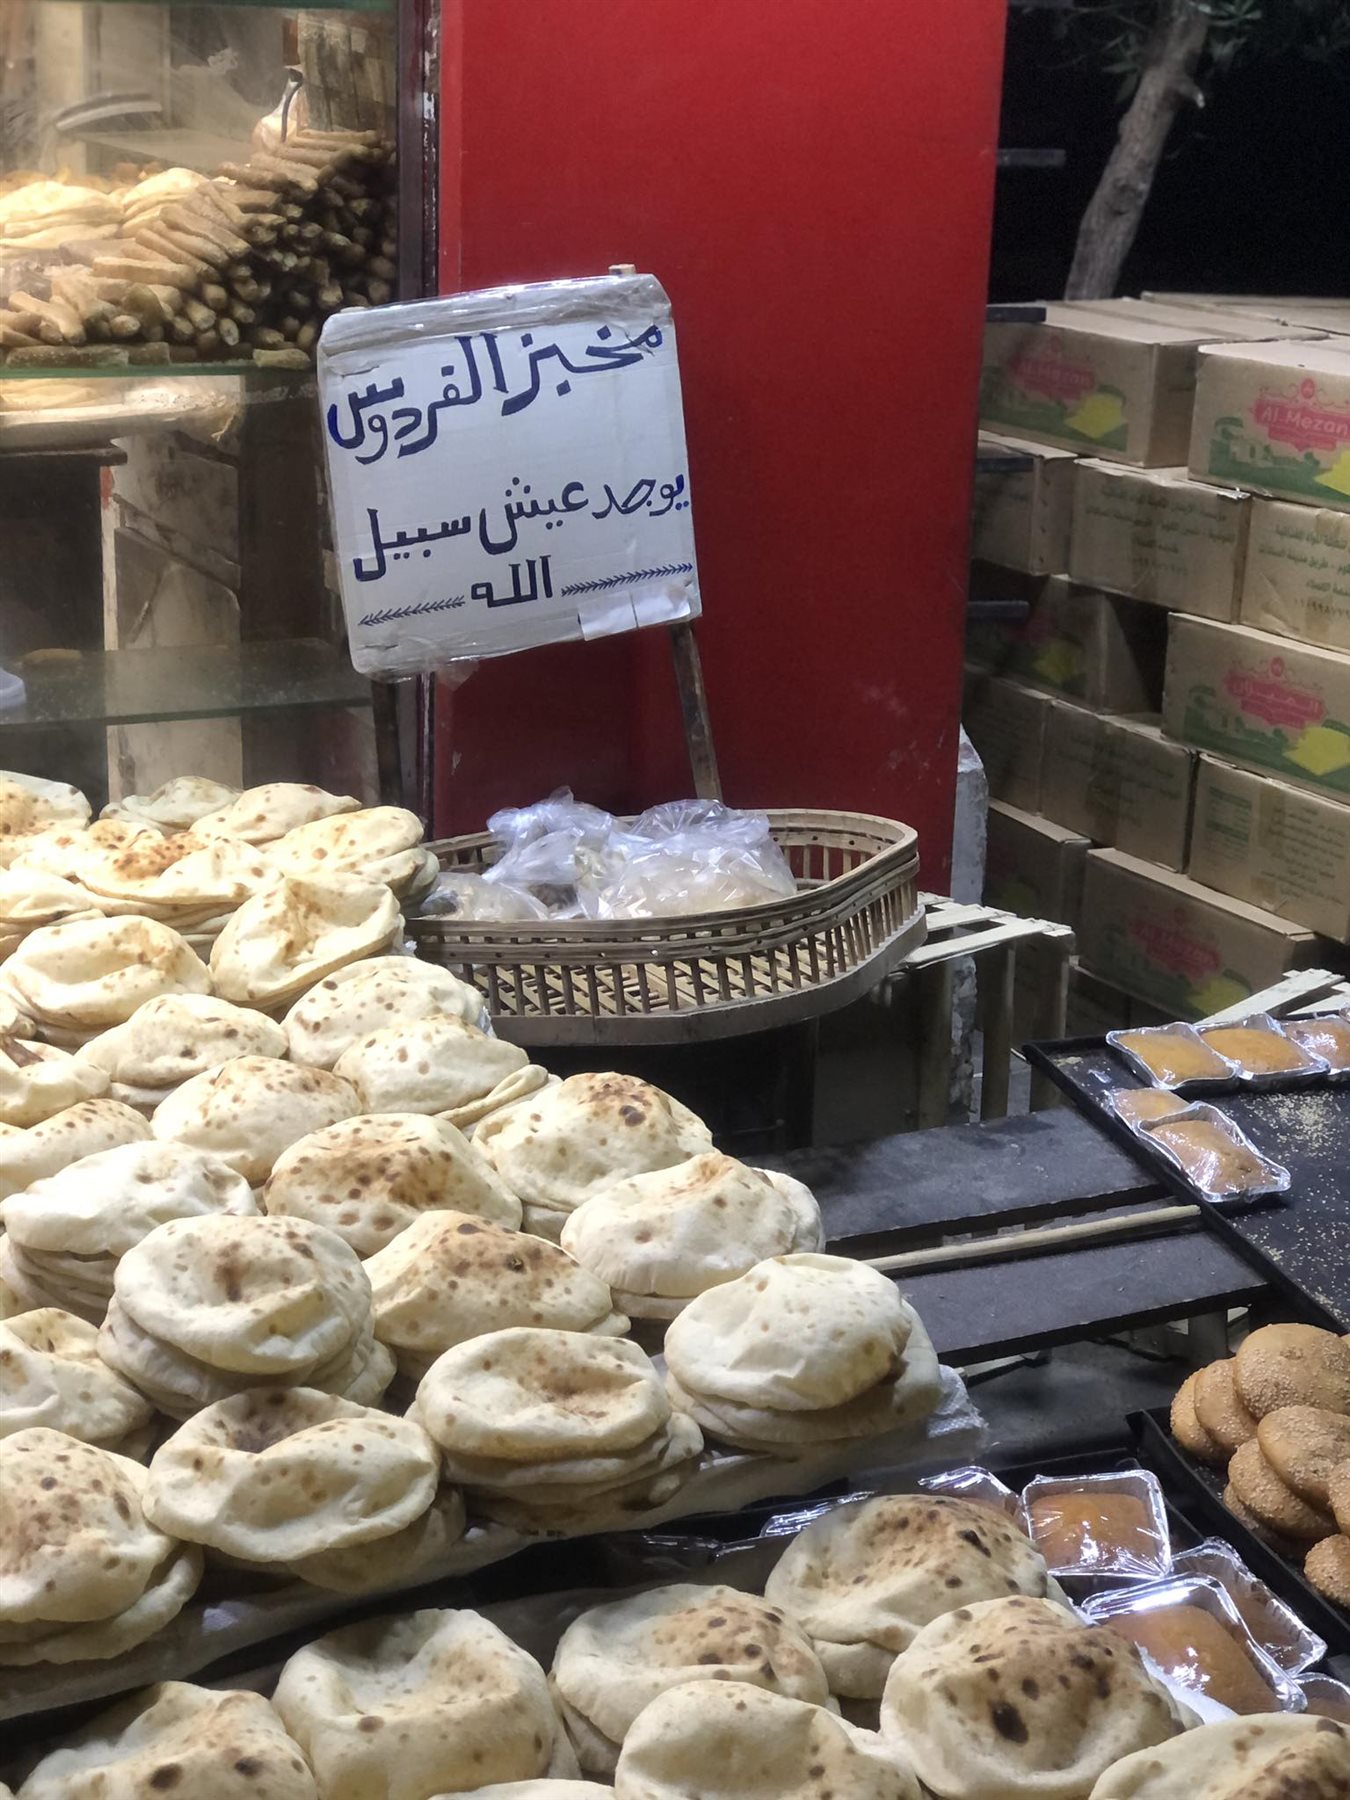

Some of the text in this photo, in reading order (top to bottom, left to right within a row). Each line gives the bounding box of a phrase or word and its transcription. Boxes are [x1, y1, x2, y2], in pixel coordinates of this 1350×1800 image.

[327, 324, 663, 466] مخبز الفردوس
[1285, 409, 1349, 436] Mezan
[353, 474, 690, 582] يوجد عيش سبيل
[471, 555, 554, 608] الله
